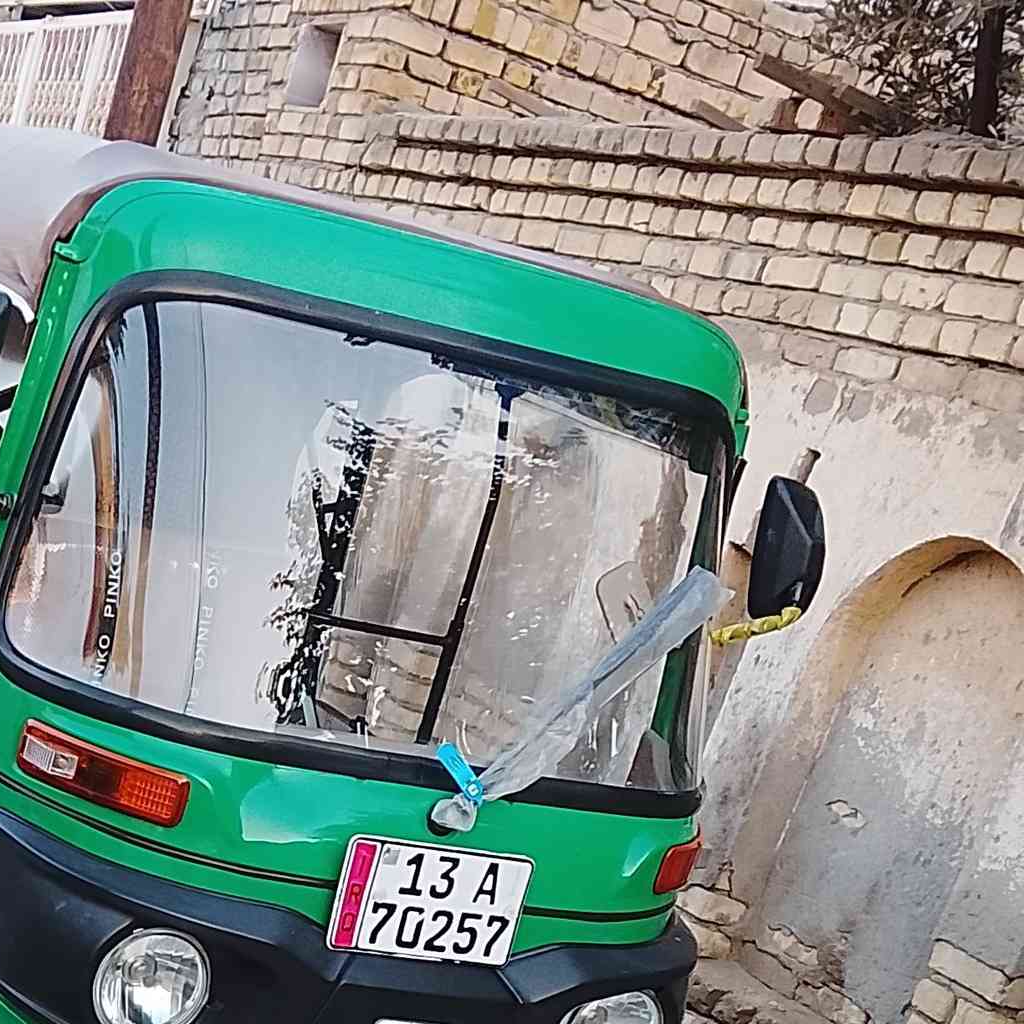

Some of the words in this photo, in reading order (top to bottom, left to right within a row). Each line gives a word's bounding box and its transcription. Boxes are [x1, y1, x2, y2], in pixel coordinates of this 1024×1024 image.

[104, 551, 123, 618] PINKO
[398, 853, 461, 900] 13
[471, 862, 500, 905] A
[369, 901, 510, 958] 70257
